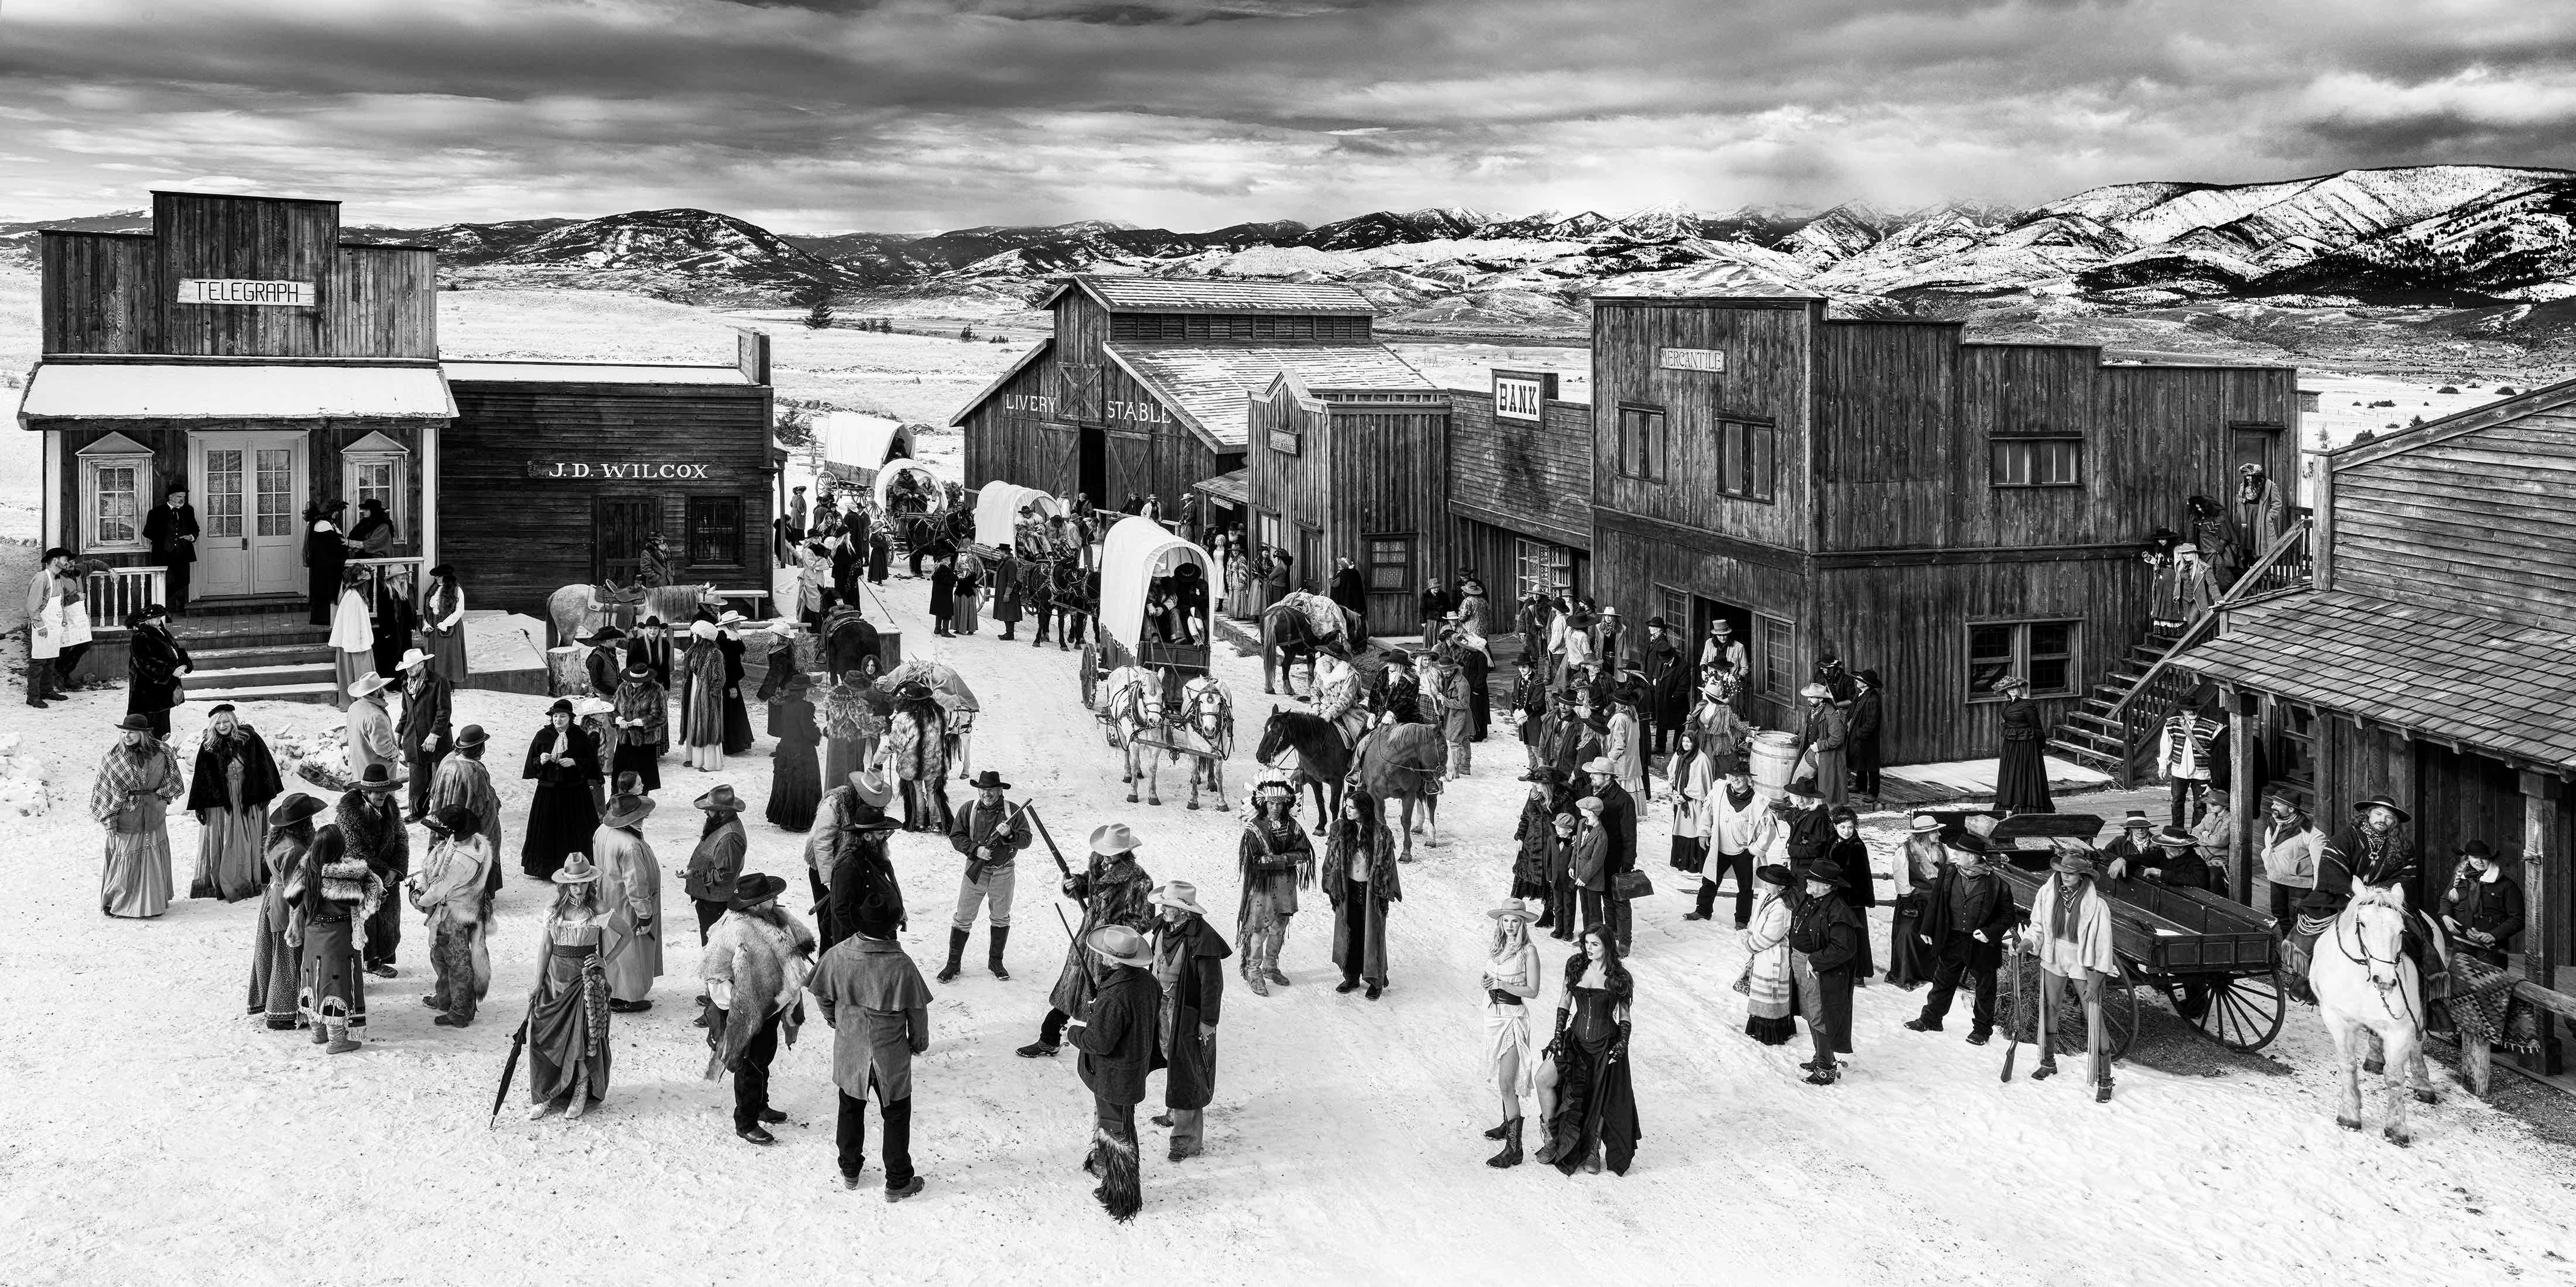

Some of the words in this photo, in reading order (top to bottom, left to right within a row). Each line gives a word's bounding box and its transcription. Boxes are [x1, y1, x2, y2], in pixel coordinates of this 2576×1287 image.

[194, 281, 299, 303] TELEGRAPH
[1661, 350, 1721, 370] MERCANTILE
[1005, 394, 1057, 413] LIVERY
[1107, 400, 1172, 424] STABLE
[1499, 383, 1537, 415] BANK
[600, 464, 709, 478] WILCOX
